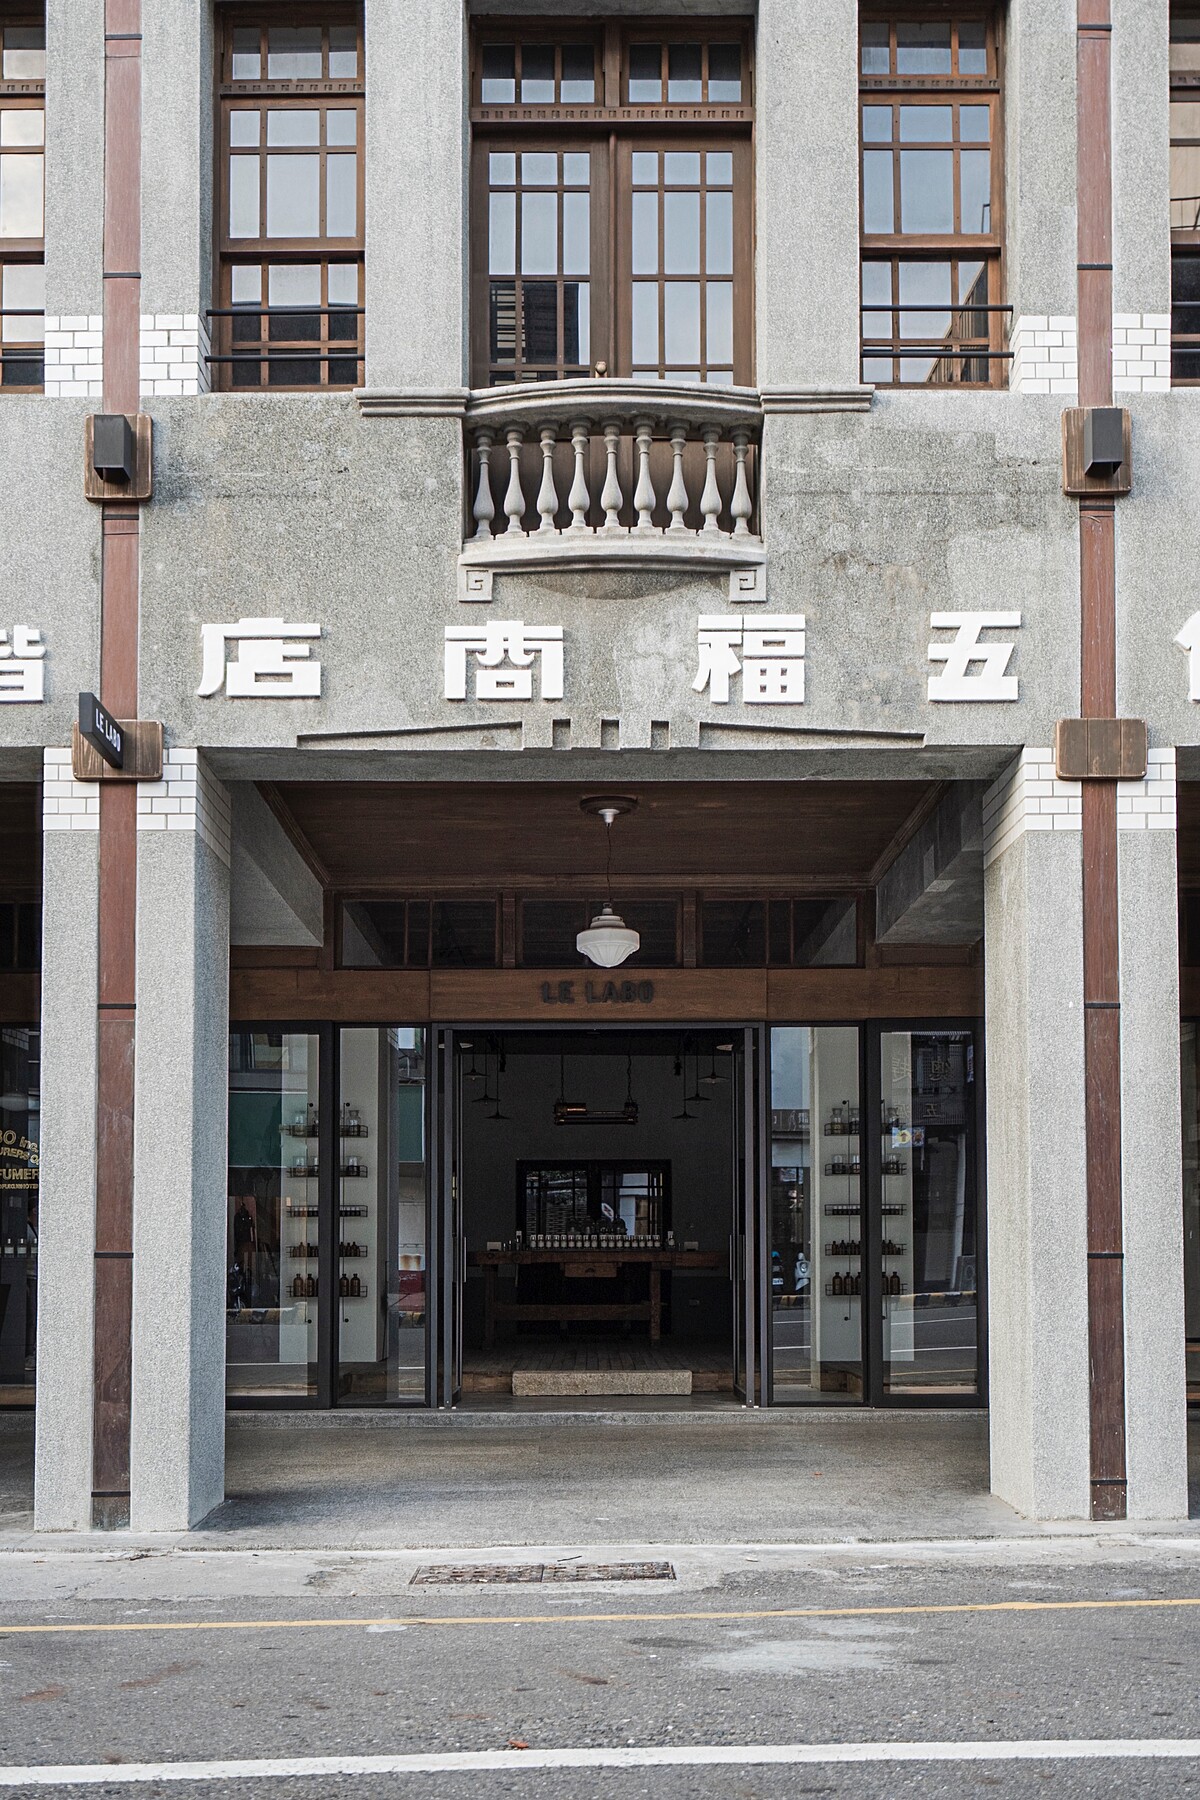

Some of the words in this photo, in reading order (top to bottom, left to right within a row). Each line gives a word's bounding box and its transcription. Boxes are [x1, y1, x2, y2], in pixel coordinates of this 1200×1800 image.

[95, 708, 105, 734] LE
[105, 720, 121, 752] LABO
[542, 981, 575, 1004] LE
[585, 981, 654, 1004] LABO
[0, 1129, 17, 1145] O
